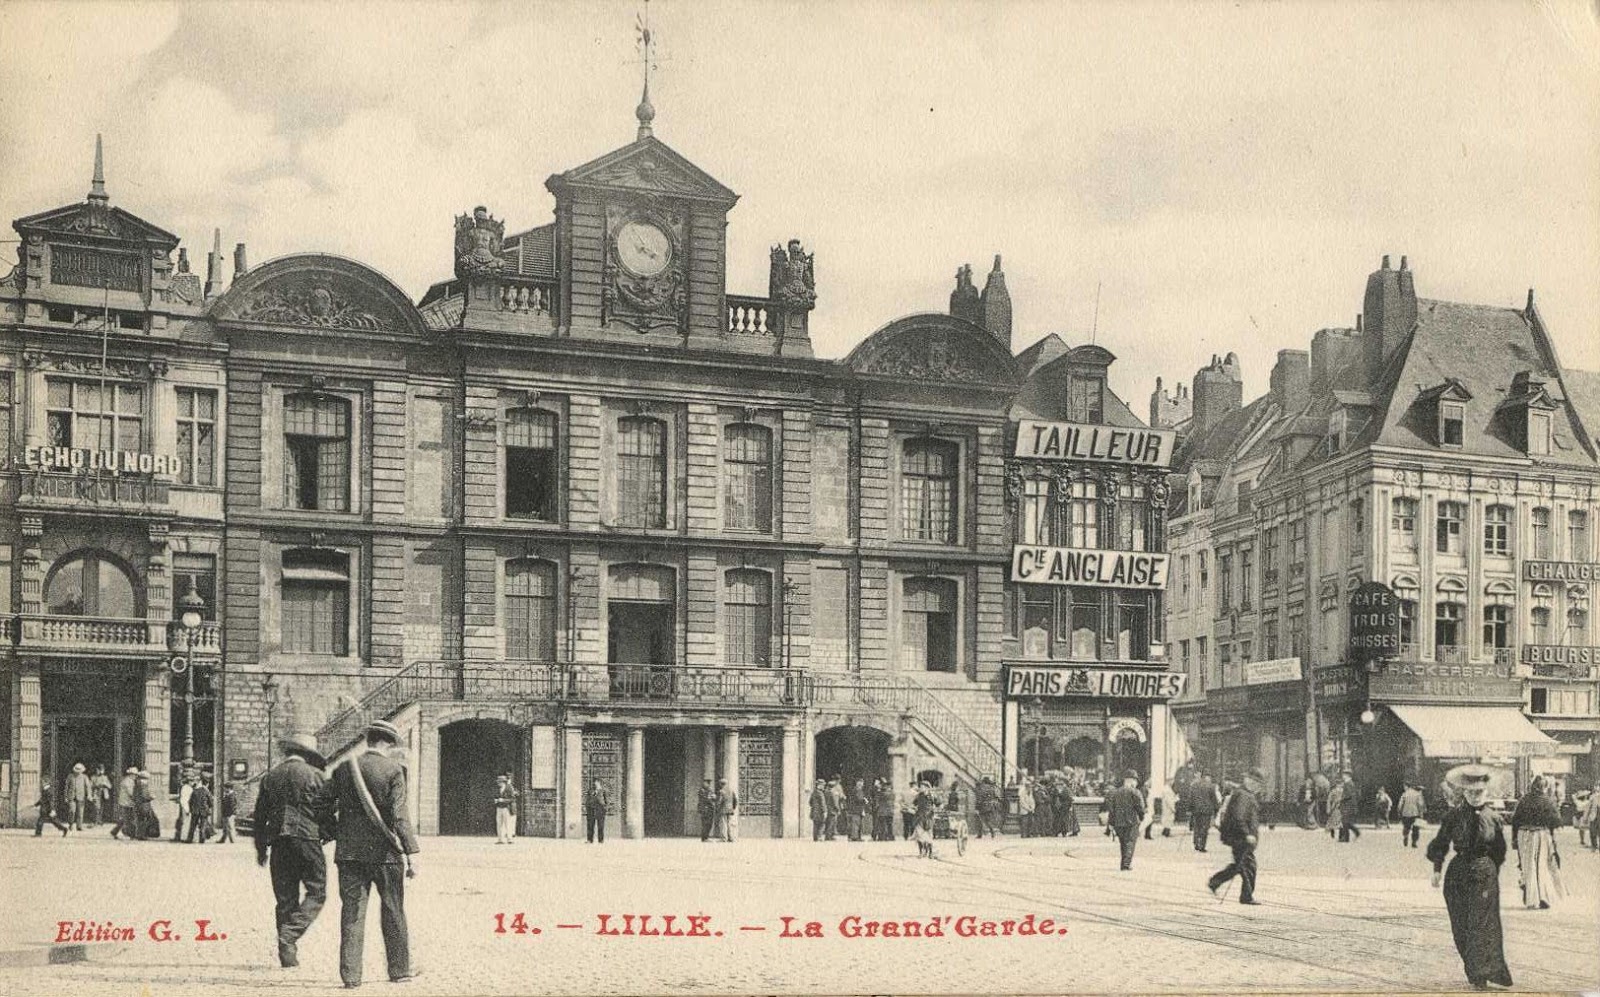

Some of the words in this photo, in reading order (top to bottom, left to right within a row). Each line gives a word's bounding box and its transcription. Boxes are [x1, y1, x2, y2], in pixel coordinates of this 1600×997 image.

[1032, 424, 1163, 462] TAILLEUR
[25, 446, 84, 469] ECHO
[90, 449, 119, 471] DU
[124, 452, 182, 475] NORD
[1048, 551, 1165, 586] ANGLAISE
[1529, 562, 1600, 579] CHANGE
[1352, 613, 1396, 627] TROIS
[1351, 634, 1398, 647] SUISSES
[1530, 645, 1600, 664] BOURSE
[1009, 670, 1061, 695] PARIS
[1099, 672, 1180, 697] LONDRES
